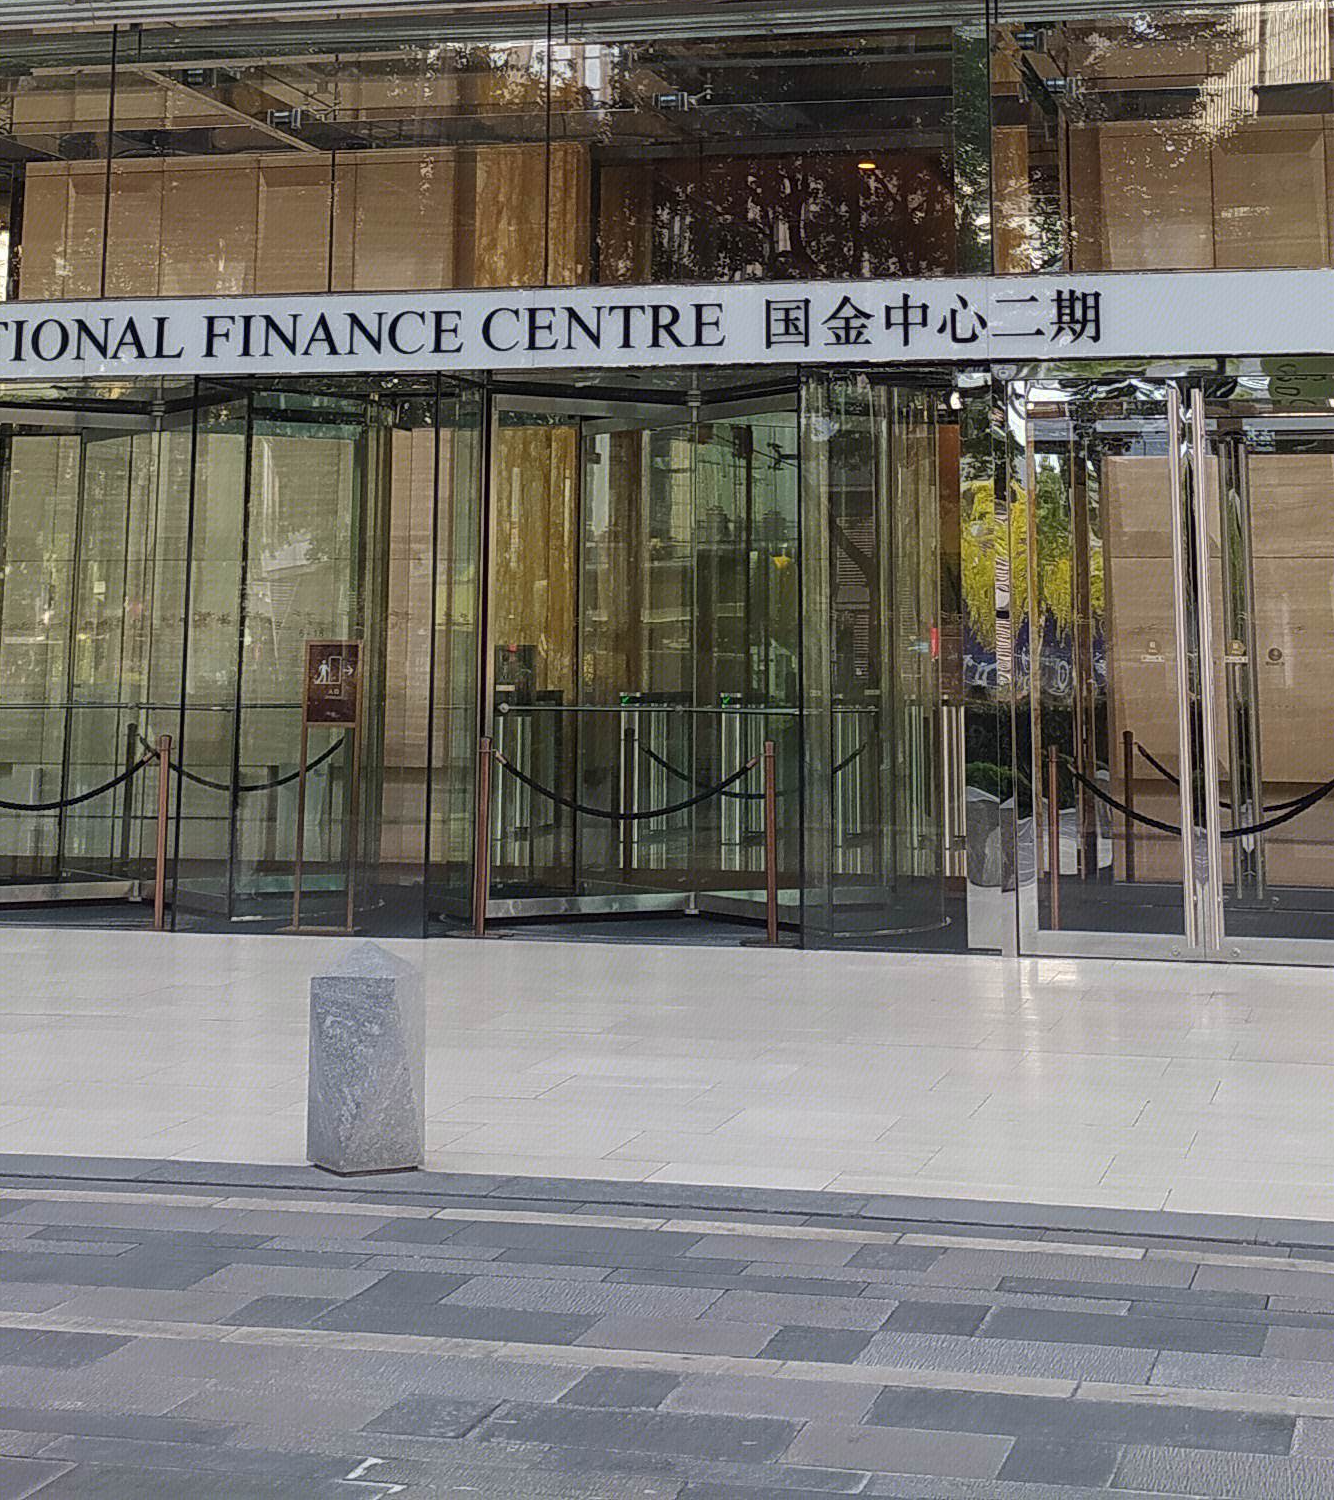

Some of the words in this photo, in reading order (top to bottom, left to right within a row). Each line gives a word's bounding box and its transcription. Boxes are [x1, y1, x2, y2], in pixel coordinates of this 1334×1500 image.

[201, 310, 464, 358] FINANCE
[481, 303, 726, 352] CENTRE
[765, 289, 1102, 350] 国金中心二期
